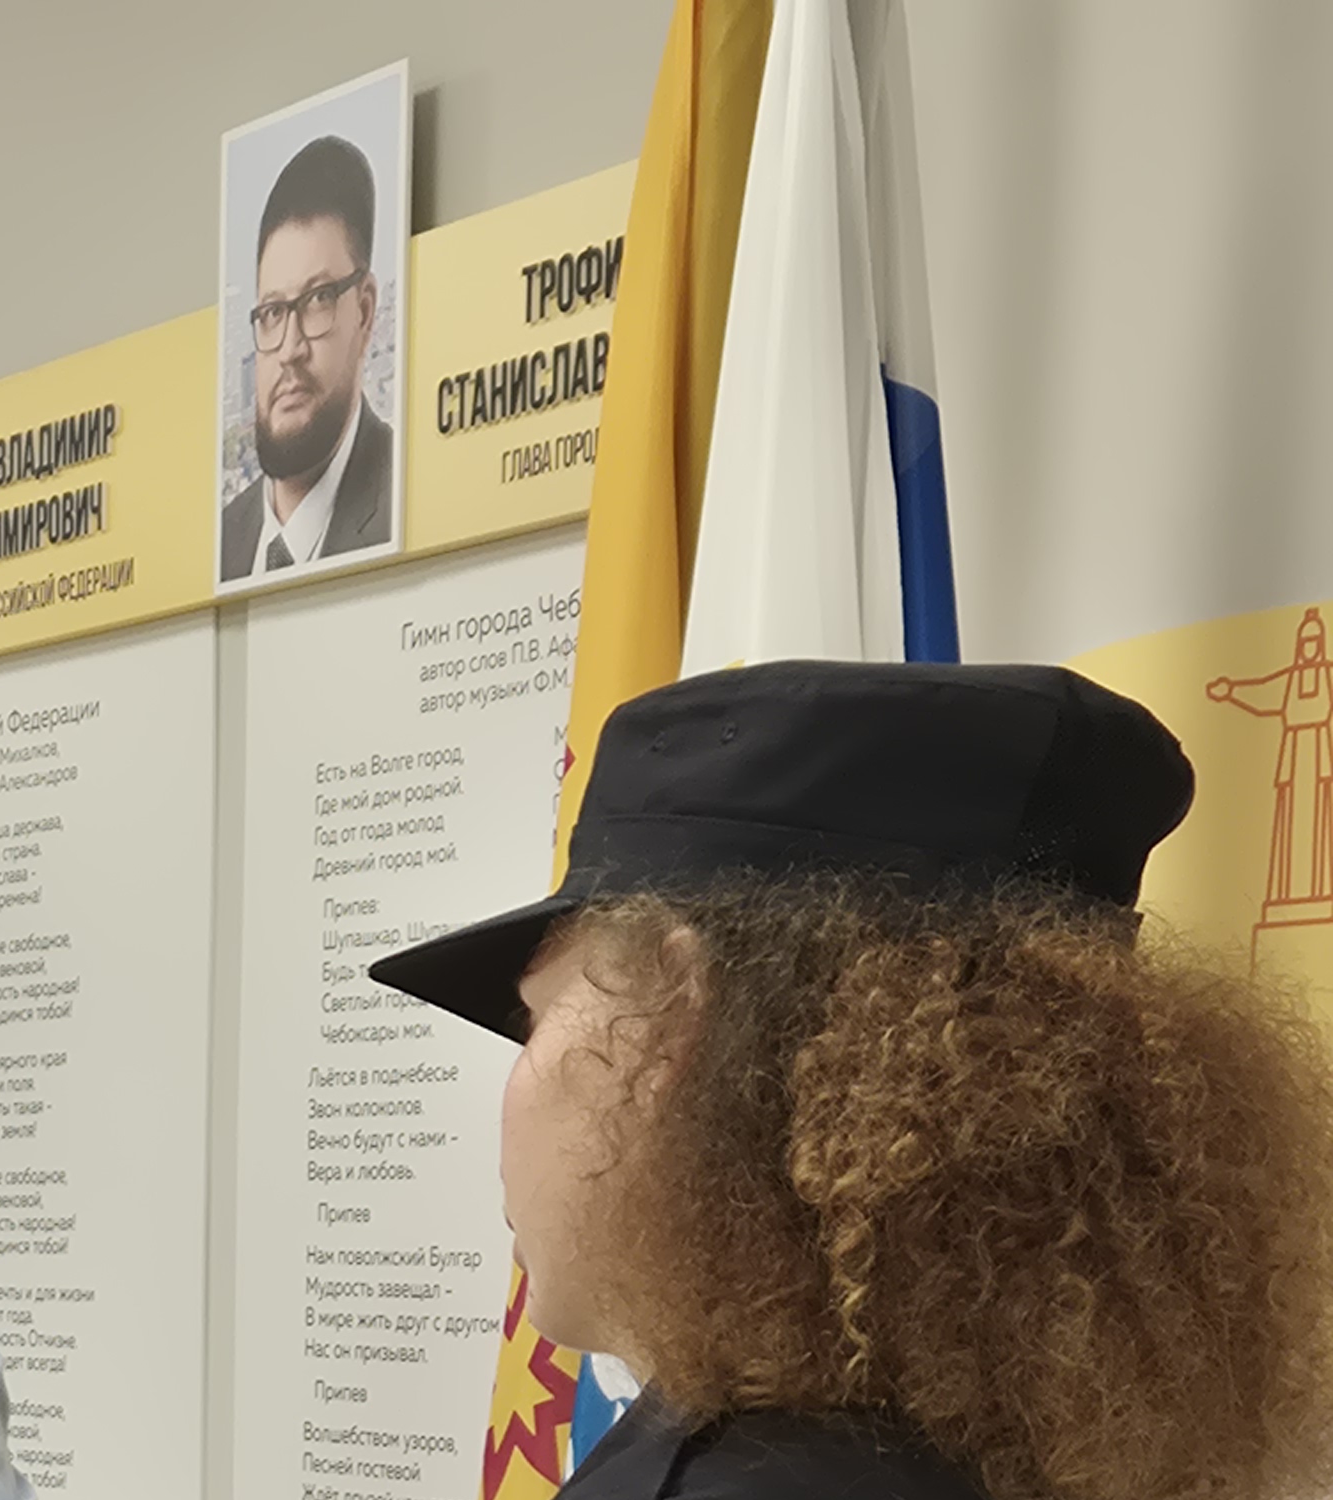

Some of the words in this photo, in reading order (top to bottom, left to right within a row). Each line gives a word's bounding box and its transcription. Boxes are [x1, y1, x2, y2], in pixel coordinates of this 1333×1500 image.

[522, 235, 625, 323] ТРОФИ
[438, 332, 610, 434] СТАНИСЛАВ
[501, 441, 552, 484] ГЛАВА
[58, 558, 134, 602] ФЕДЕРАЦИИ
[402, 622, 450, 650] Гимн
[457, 607, 532, 639] города
[539, 588, 580, 622] Чеб
[420, 659, 465, 682] автор
[469, 652, 507, 673] слов
[420, 691, 465, 714] автор
[470, 681, 529, 708] музыки
[316, 763, 346, 784] Есть
[350, 762, 367, 777] на
[371, 754, 413, 775] Волге
[316, 794, 338, 816] Где
[341, 790, 369, 810] мой
[371, 790, 401, 810] дом
[315, 825, 337, 847] Год
[341, 827, 356, 843] от
[361, 822, 393, 841] года
[397, 815, 444, 835] молод
[313, 852, 375, 880] Древний
[380, 851, 422, 872] город
[324, 962, 353, 981] Будь
[322, 993, 380, 1012] Светлый
[321, 1023, 398, 1044] Чебоксары
[308, 1067, 356, 1088] Льётся
[360, 1071, 368, 1085] в
[372, 1062, 458, 1086] поднебесье
[309, 1099, 341, 1119] Звон
[308, 1130, 350, 1150] Вечно
[354, 1129, 393, 1151] будут
[398, 1133, 404, 1148] с
[409, 1132, 445, 1148] нами
[308, 1161, 341, 1183] Вера
[346, 1167, 354, 1179] и
[318, 1202, 370, 1224] Припев
[307, 1246, 334, 1264] Нам
[338, 1248, 425, 1266] поволжский
[430, 1246, 481, 1270] Булгар
[306, 1277, 374, 1300] Мудрость
[378, 1283, 440, 1301] завещал
[306, 1307, 315, 1326] В
[319, 1313, 353, 1331] мире
[357, 1315, 392, 1329] жить
[395, 1315, 429, 1334] друг
[433, 1317, 440, 1332] с
[444, 1317, 499, 1336] другом
[305, 1339, 329, 1358] Нас
[334, 1344, 350, 1359] он
[315, 1379, 367, 1403] Припев
[304, 1421, 399, 1447] Волшебством
[303, 1452, 353, 1475] Песней
[357, 1462, 420, 1481] гостевой
